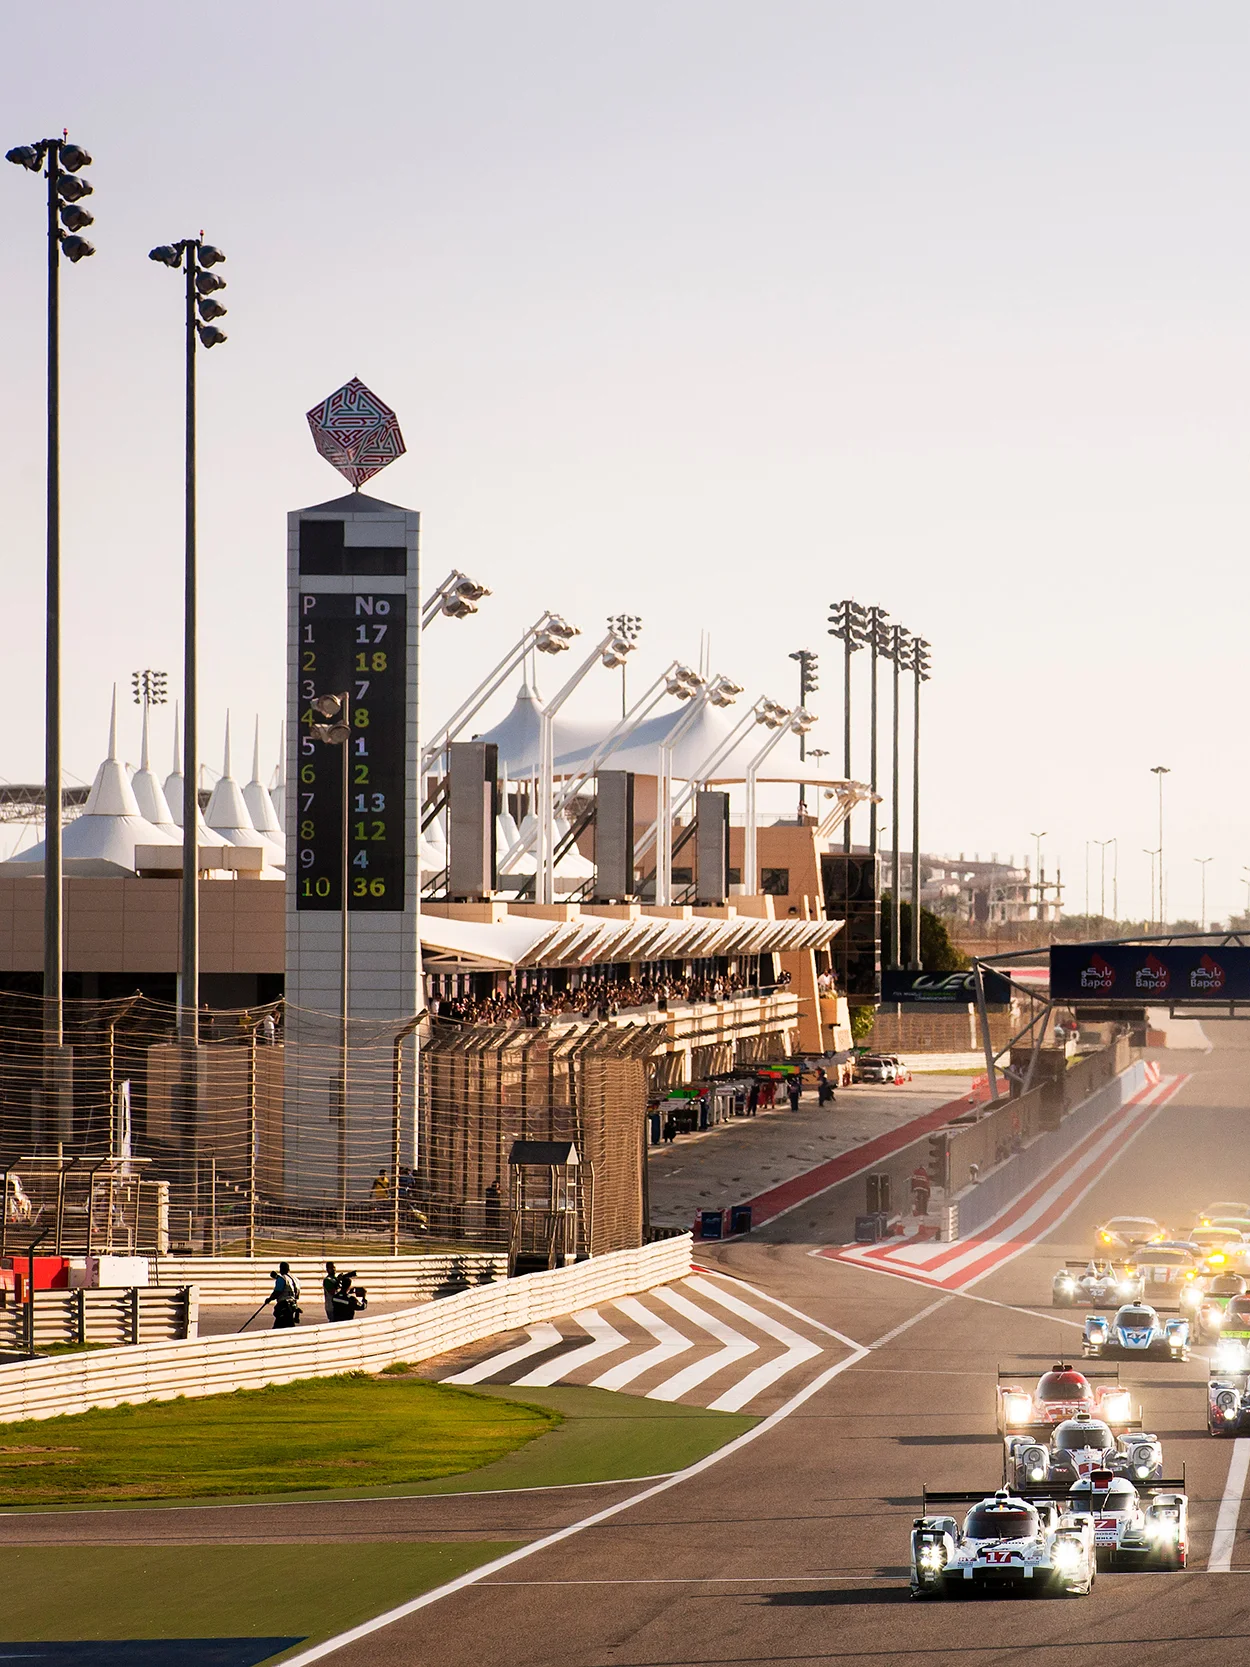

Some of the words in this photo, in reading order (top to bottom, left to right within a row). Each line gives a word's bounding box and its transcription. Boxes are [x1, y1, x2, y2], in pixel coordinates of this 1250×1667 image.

[303, 596, 316, 615] P
[355, 596, 390, 615] No
[304, 624, 315, 643] 1
[356, 624, 388, 643] 17
[303, 651, 316, 671] 2
[355, 652, 387, 672] 18
[302, 680, 315, 699] 3
[355, 681, 370, 699] 7
[301, 708, 315, 727] 4
[354, 708, 369, 728] 8
[302, 736, 315, 756] 5
[355, 737, 368, 756] 1
[301, 764, 316, 784] 6
[354, 764, 369, 784] 2
[302, 793, 315, 812] 7
[355, 793, 385, 812] 13
[301, 820, 315, 840] 8
[355, 821, 386, 841] 12
[300, 849, 315, 868] 9
[353, 850, 369, 868] 4
[302, 877, 331, 897] 10
[353, 877, 386, 897] 36
[1081, 978, 1112, 989] Bapco
[1135, 979, 1167, 989] Bapco
[1190, 979, 1222, 989] Bapco
[987, 1551, 1010, 1563] 17
